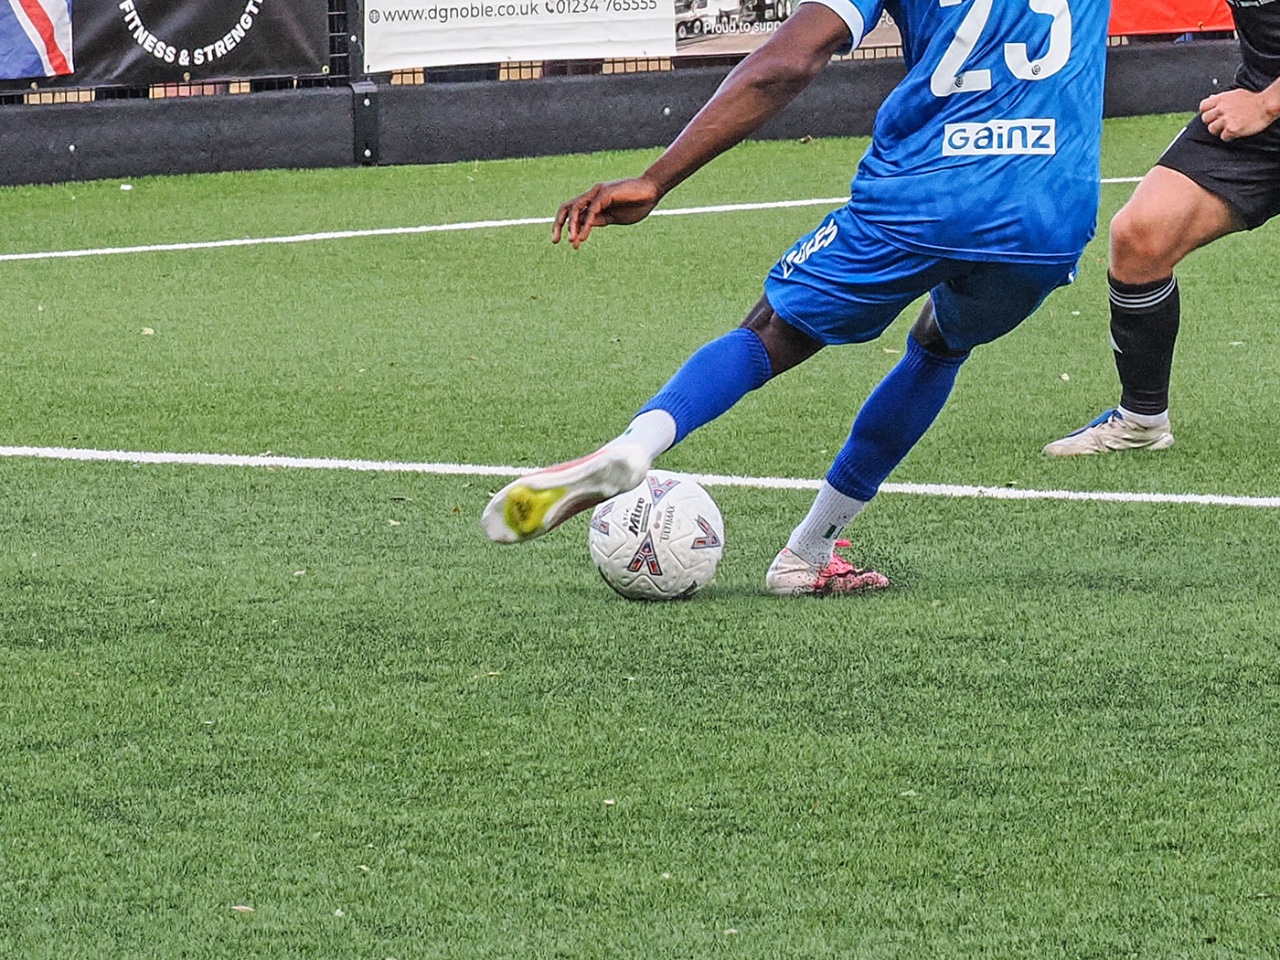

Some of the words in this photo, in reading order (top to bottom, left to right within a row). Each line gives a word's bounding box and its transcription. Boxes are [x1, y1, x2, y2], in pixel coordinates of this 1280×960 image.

[382, 0, 539, 23] www.dgnoble.co.uk
[703, 21, 736, 34] Proud
[739, 21, 751, 33] to
[753, 21, 782, 34] supp
[178, 49, 190, 66] &
[628, 496, 646, 538] Mitre
